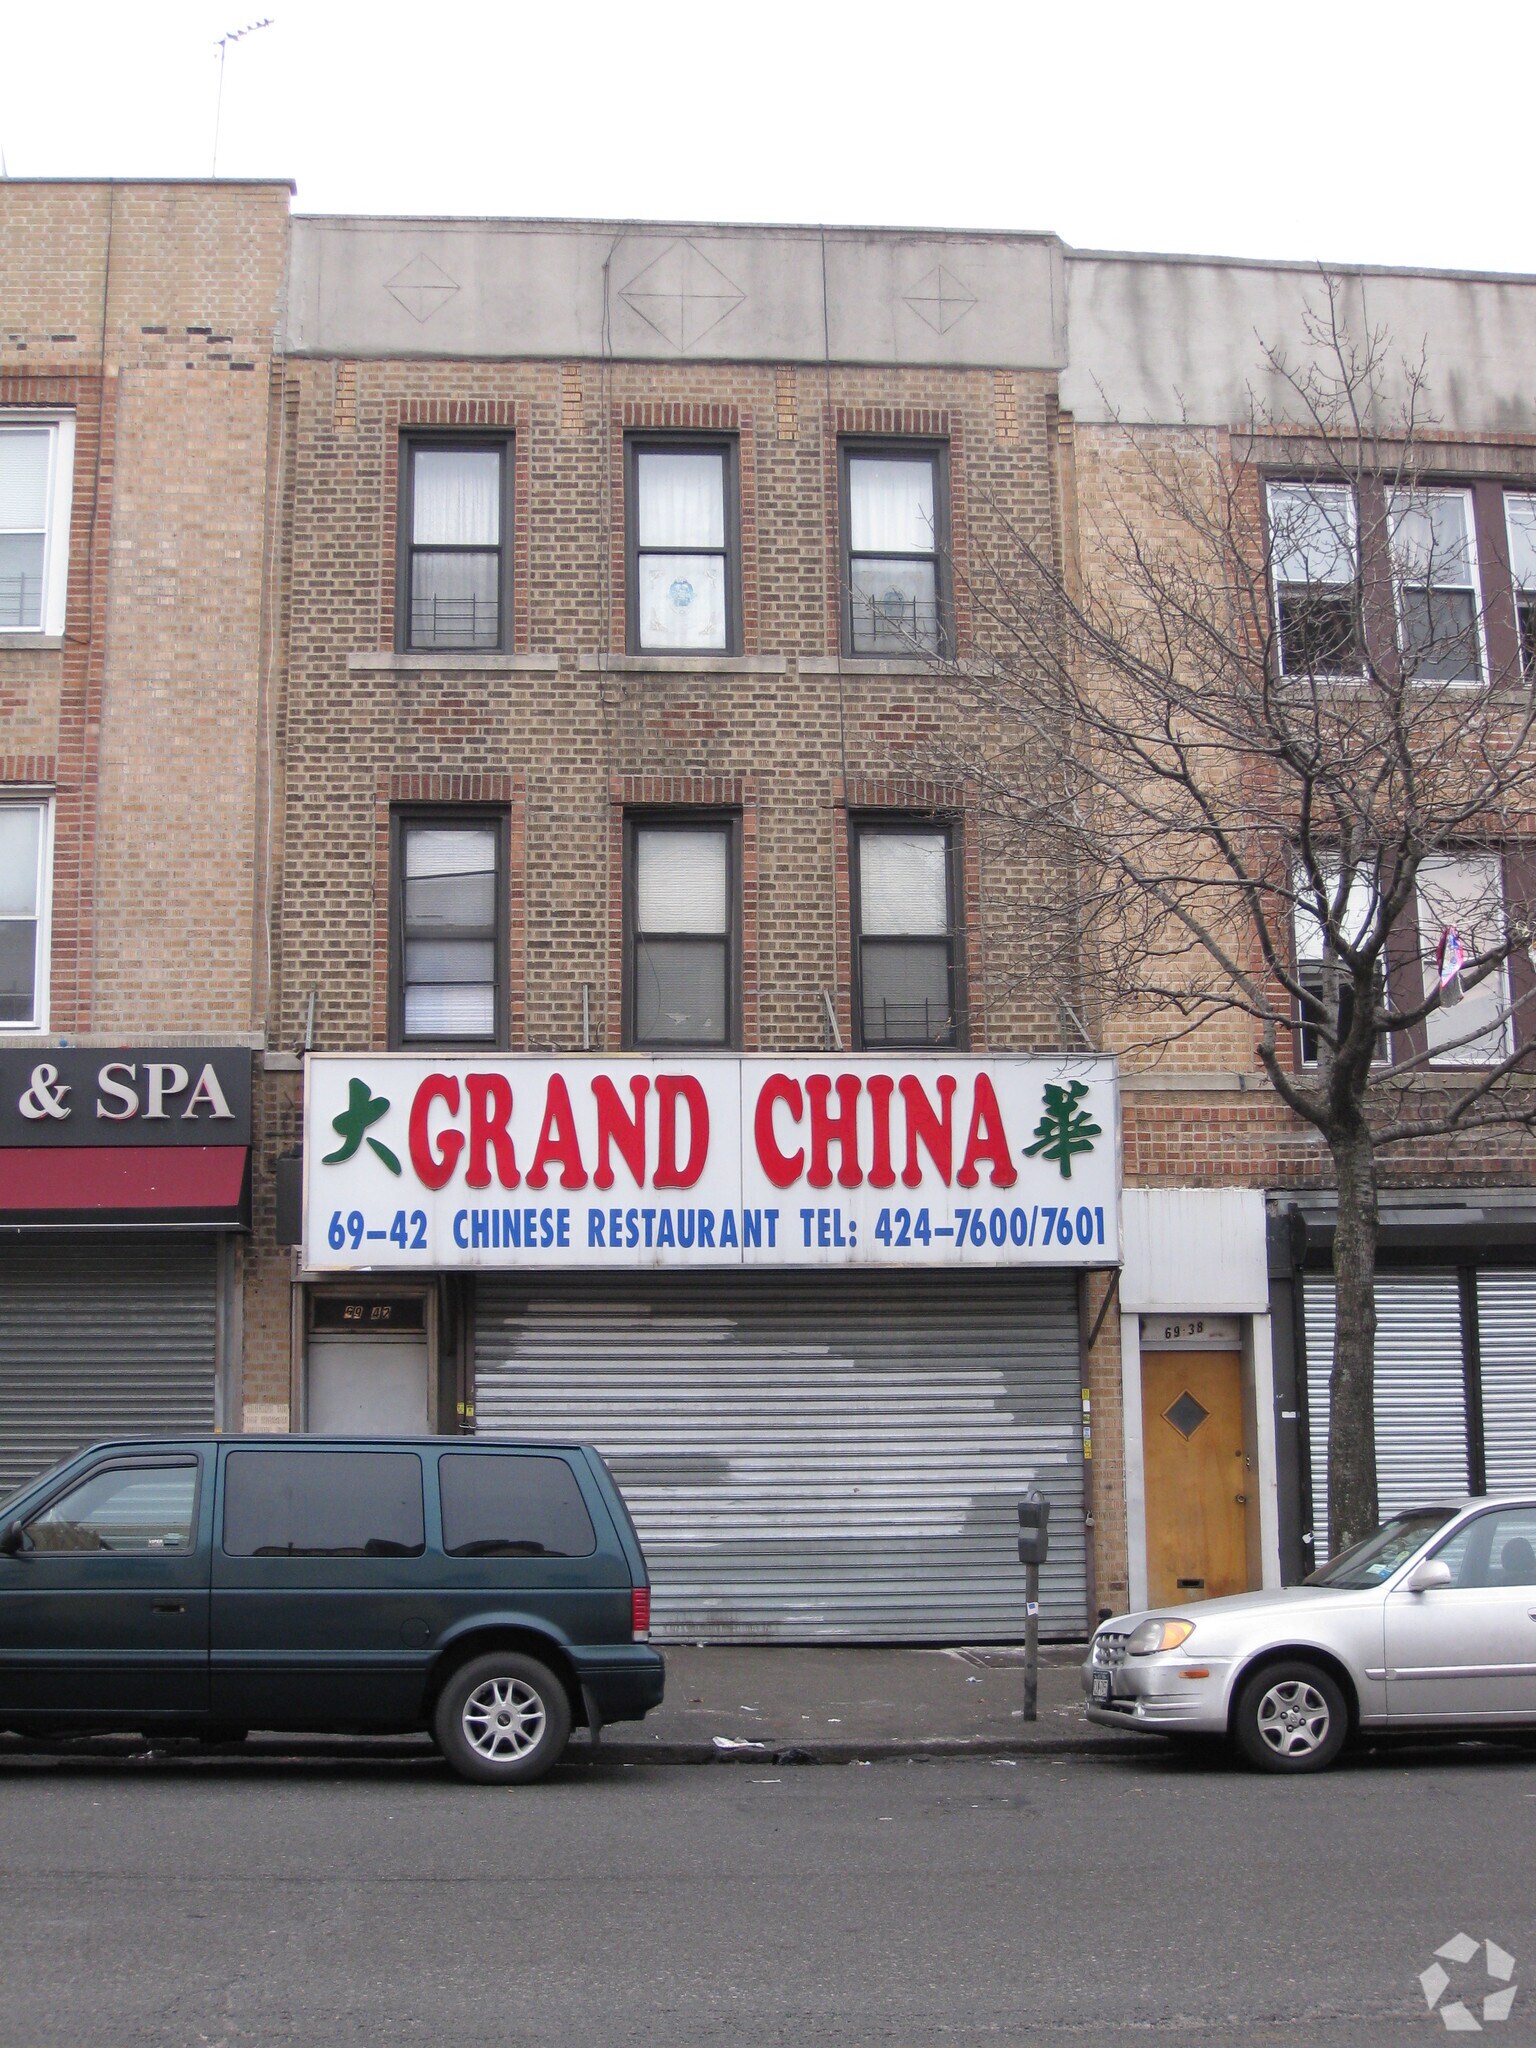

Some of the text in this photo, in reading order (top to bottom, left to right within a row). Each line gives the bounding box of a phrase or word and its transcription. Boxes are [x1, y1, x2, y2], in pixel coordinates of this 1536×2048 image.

[18, 1062, 236, 1120] & SPA
[321, 1077, 402, 1177] 大
[1021, 1079, 1103, 1180] 華
[408, 1072, 1018, 1190] GRAND CHINA
[328, 1205, 1105, 1250] 69-42 CHINESE RESTAURANT TEL: 424-7600/7601
[343, 1305, 363, 1319] 69
